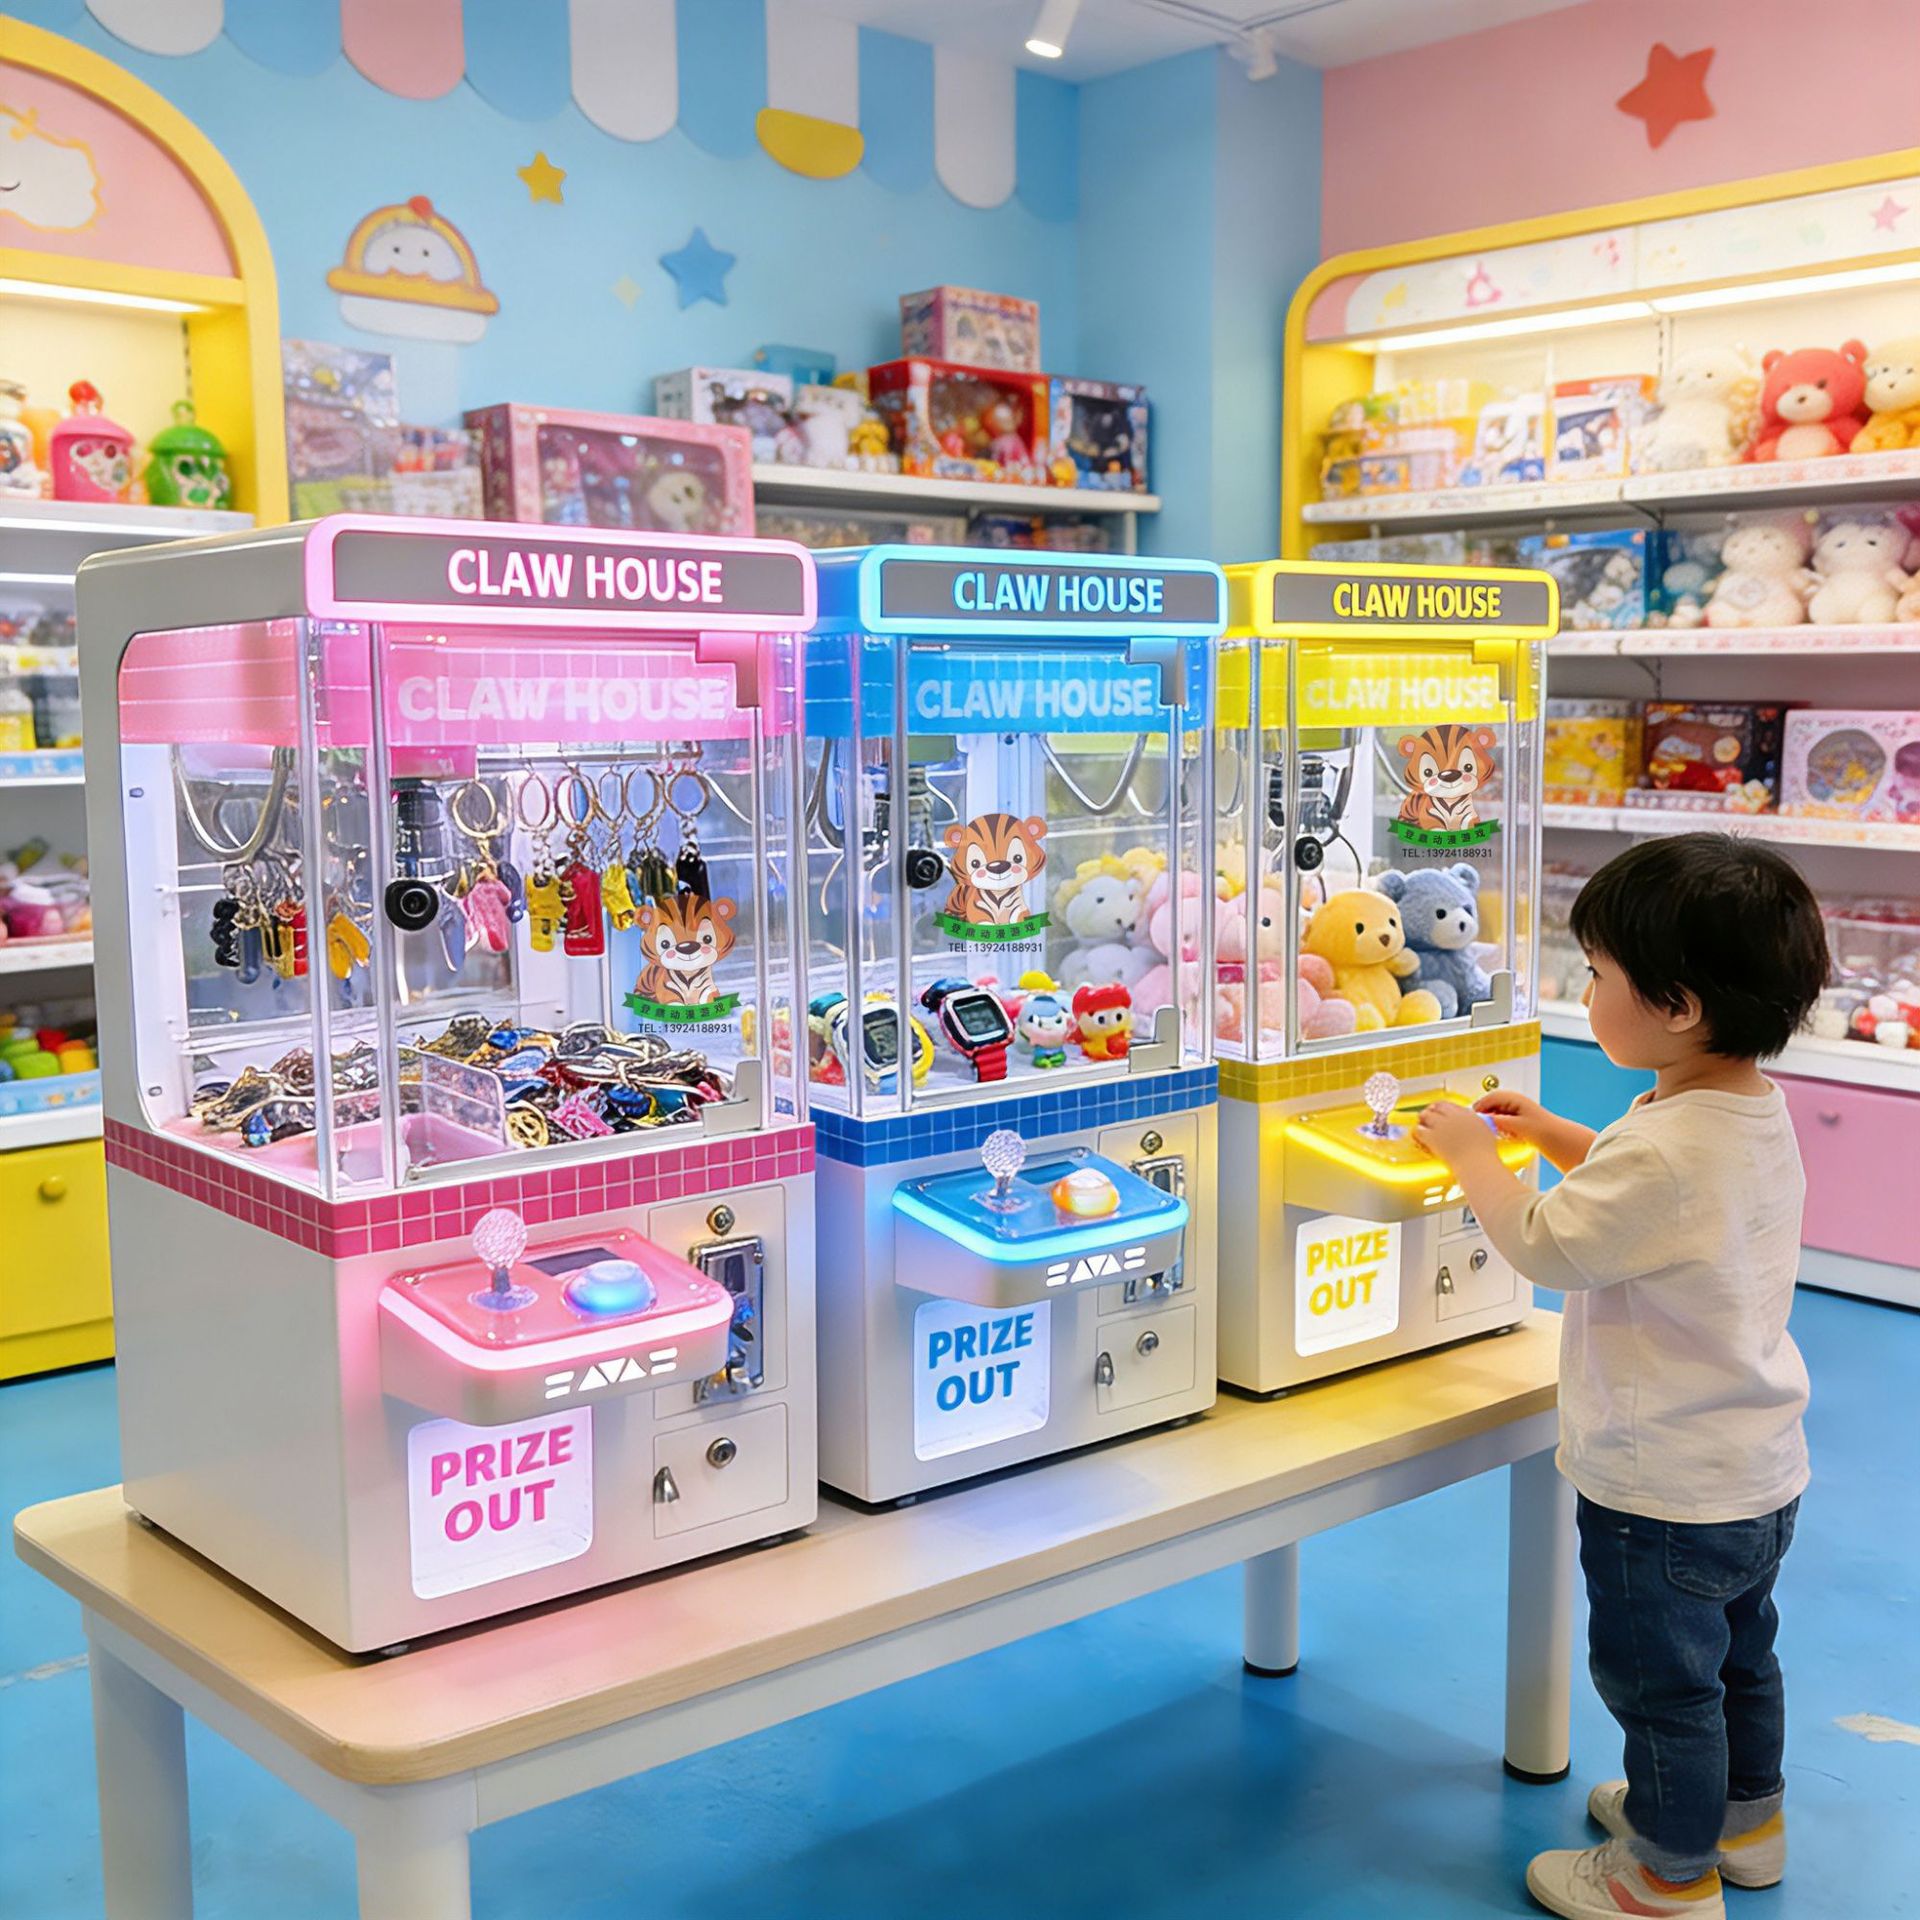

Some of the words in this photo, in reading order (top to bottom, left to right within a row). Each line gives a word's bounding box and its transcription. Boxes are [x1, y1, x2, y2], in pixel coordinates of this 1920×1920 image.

[448, 549, 573, 598] CLAW
[586, 557, 724, 604] HOUSE
[952, 571, 1050, 613] CLAW
[1058, 576, 1165, 614] HOUSE
[1333, 583, 1411, 618] CLAW
[1417, 585, 1502, 619] HOUSE
[398, 676, 549, 721] CLAW
[562, 677, 727, 722] HOUSE
[916, 679, 1024, 719] CLAW
[1036, 678, 1153, 718] HOUSE
[1306, 676, 1392, 711] CLAW
[1401, 675, 1495, 710] HOUSE
[1306, 1229, 1388, 1276] PRIZE
[1309, 1271, 1378, 1316] OUT
[928, 1312, 1034, 1369] PRIZE
[936, 1361, 1020, 1412] OUT
[431, 1425, 573, 1496] PRIZE
[445, 1479, 555, 1542] OUT
